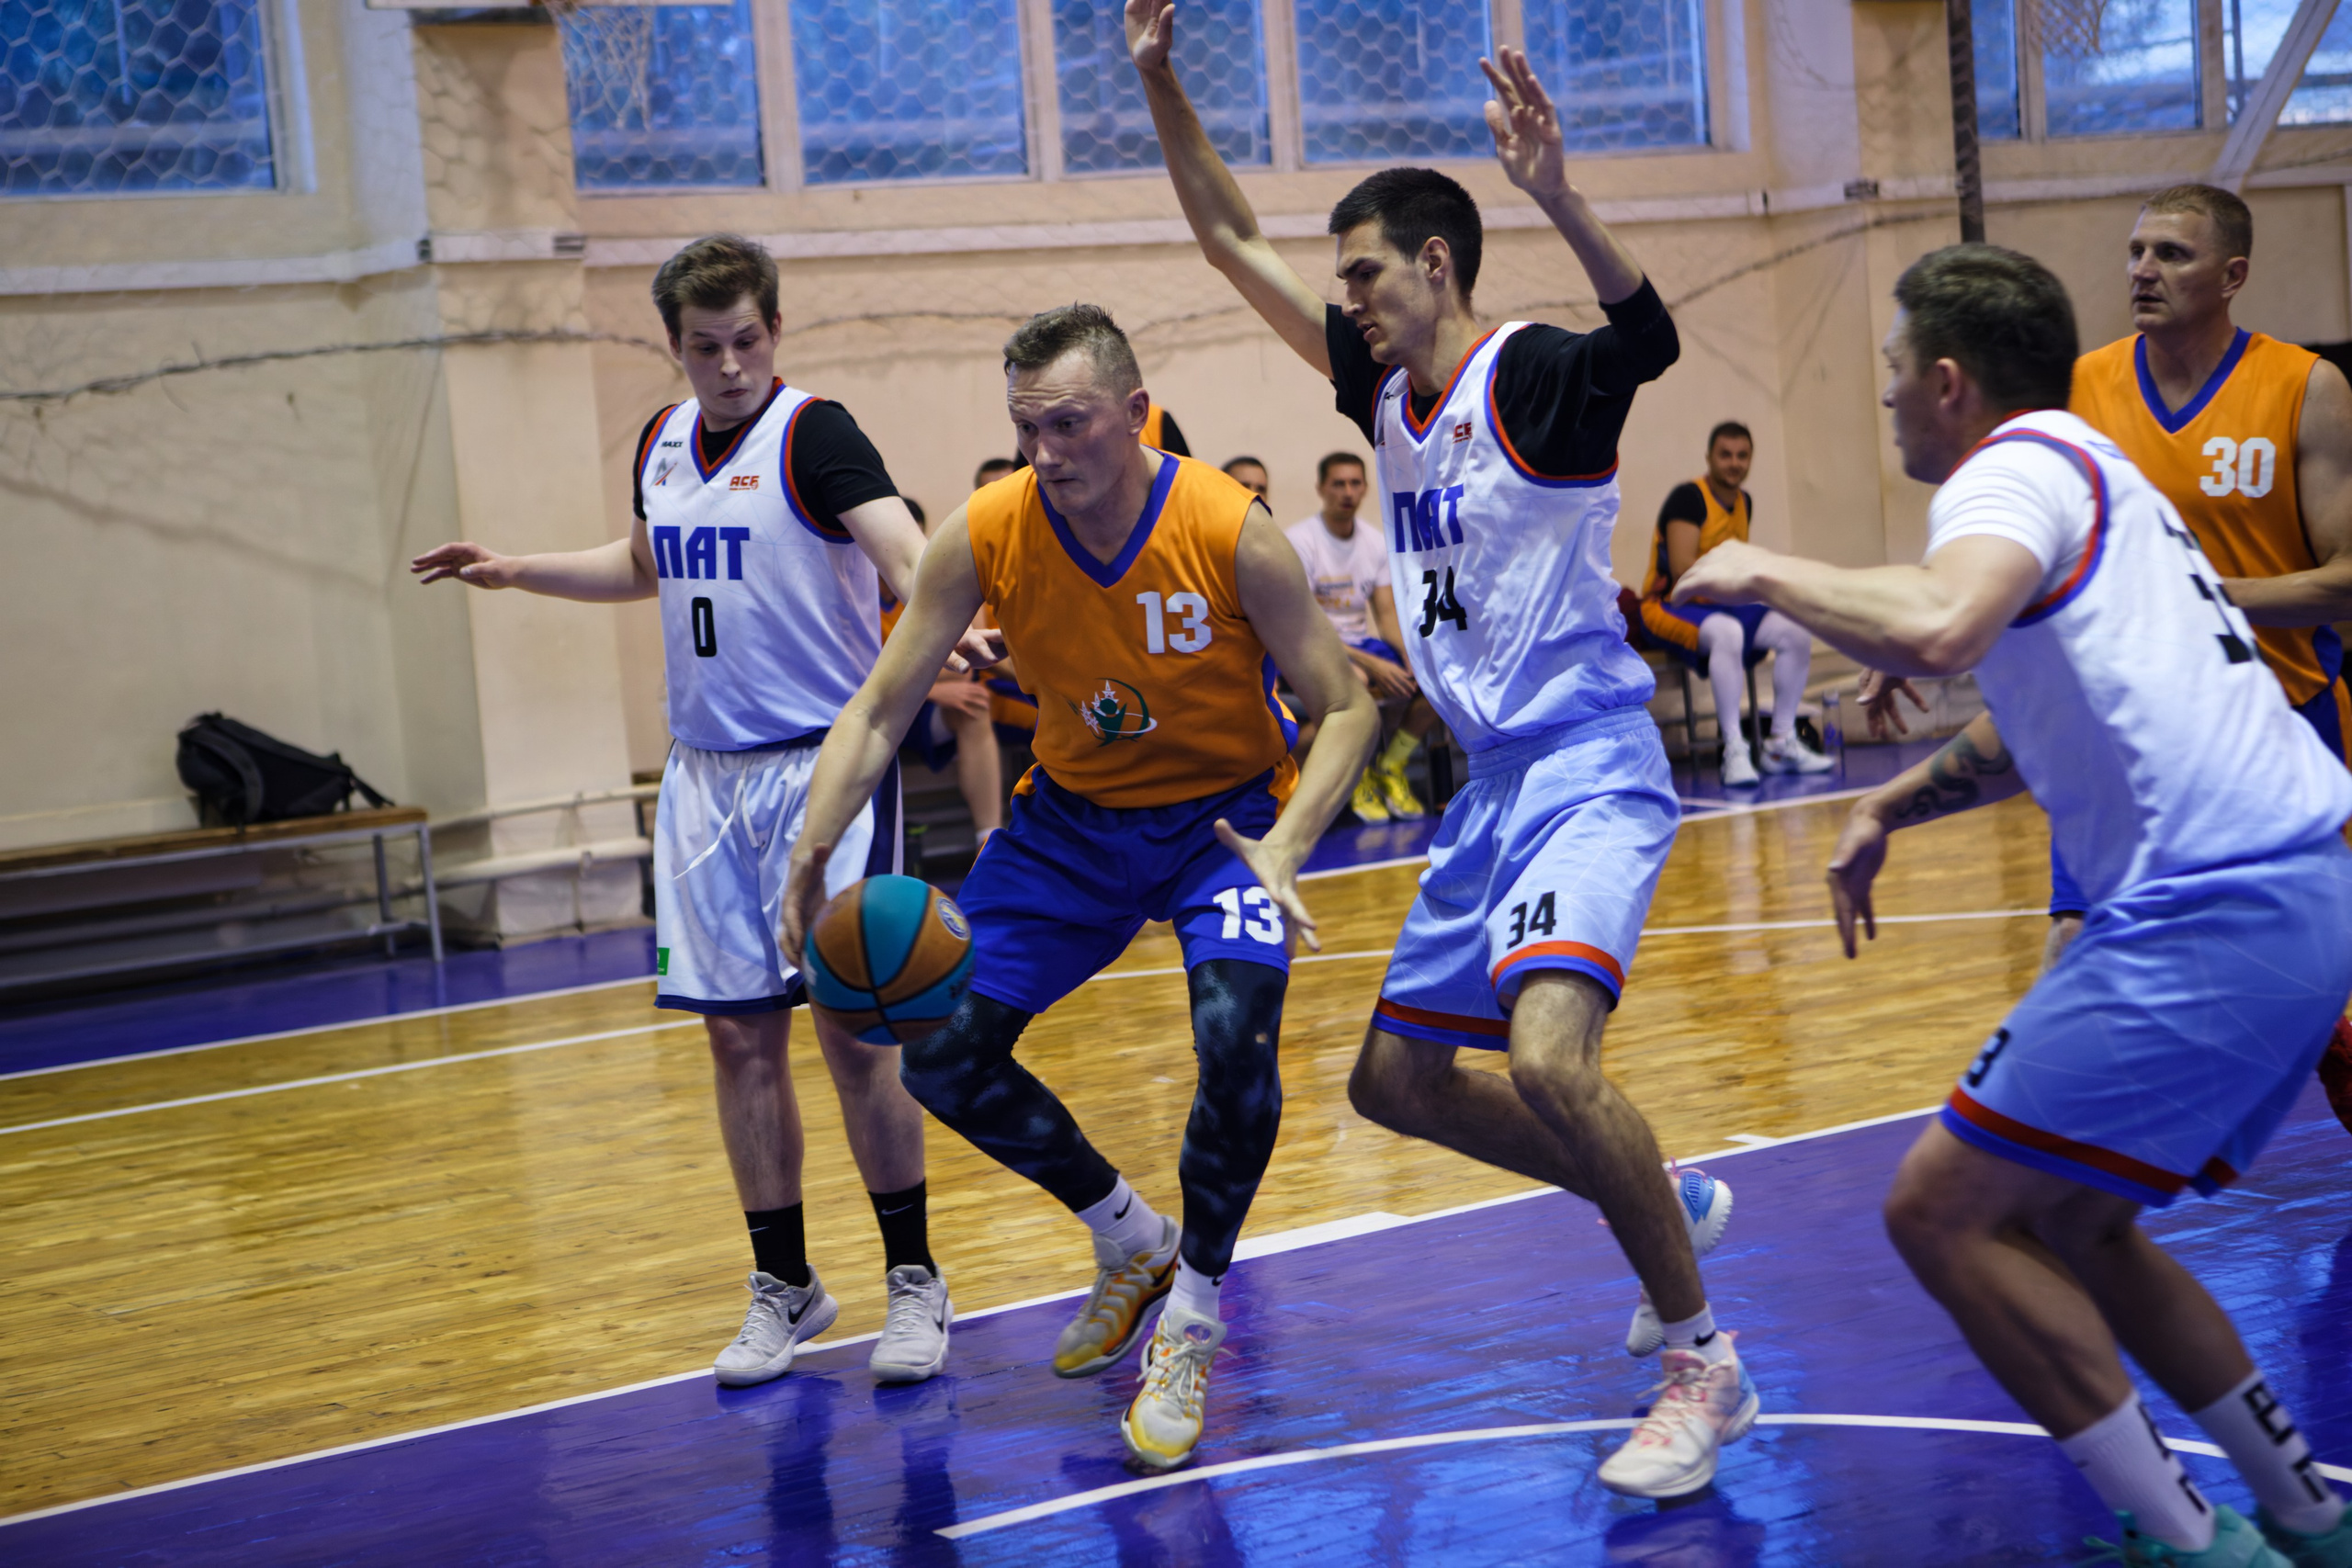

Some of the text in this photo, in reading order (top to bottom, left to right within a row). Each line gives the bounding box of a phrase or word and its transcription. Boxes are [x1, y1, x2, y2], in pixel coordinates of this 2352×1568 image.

[2199, 436, 2276, 498] 30
[1393, 482, 1464, 553] ПАТ
[653, 525, 750, 581] ПАТ
[691, 596, 718, 658] 0
[1136, 591, 1212, 654] 13
[1419, 566, 1467, 637] 34
[1213, 886, 1284, 945] 13
[1507, 890, 1556, 950] 34
